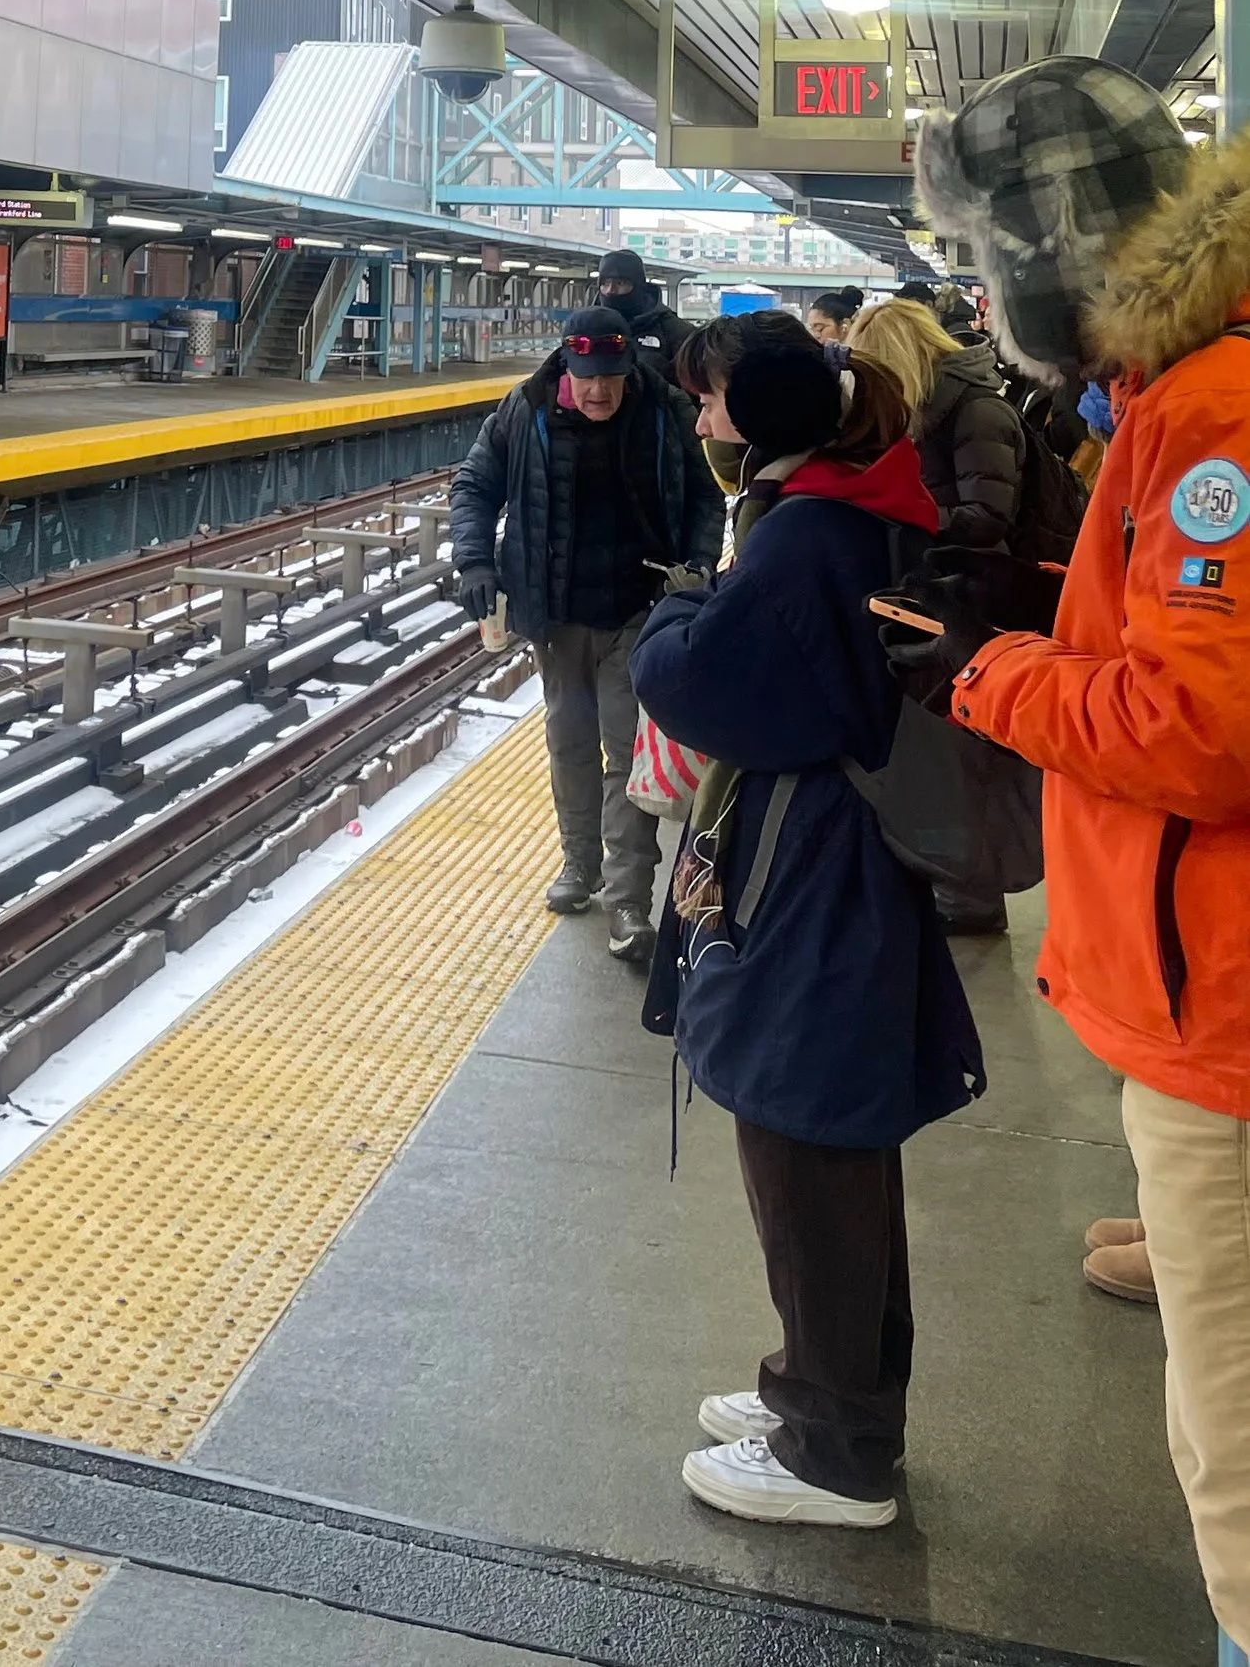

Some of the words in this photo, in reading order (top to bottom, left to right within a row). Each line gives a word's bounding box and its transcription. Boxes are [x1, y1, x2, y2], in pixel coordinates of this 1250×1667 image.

[797, 66, 866, 114] EXIT
[8, 200, 31, 209] Station
[1210, 487, 1232, 513] 50
